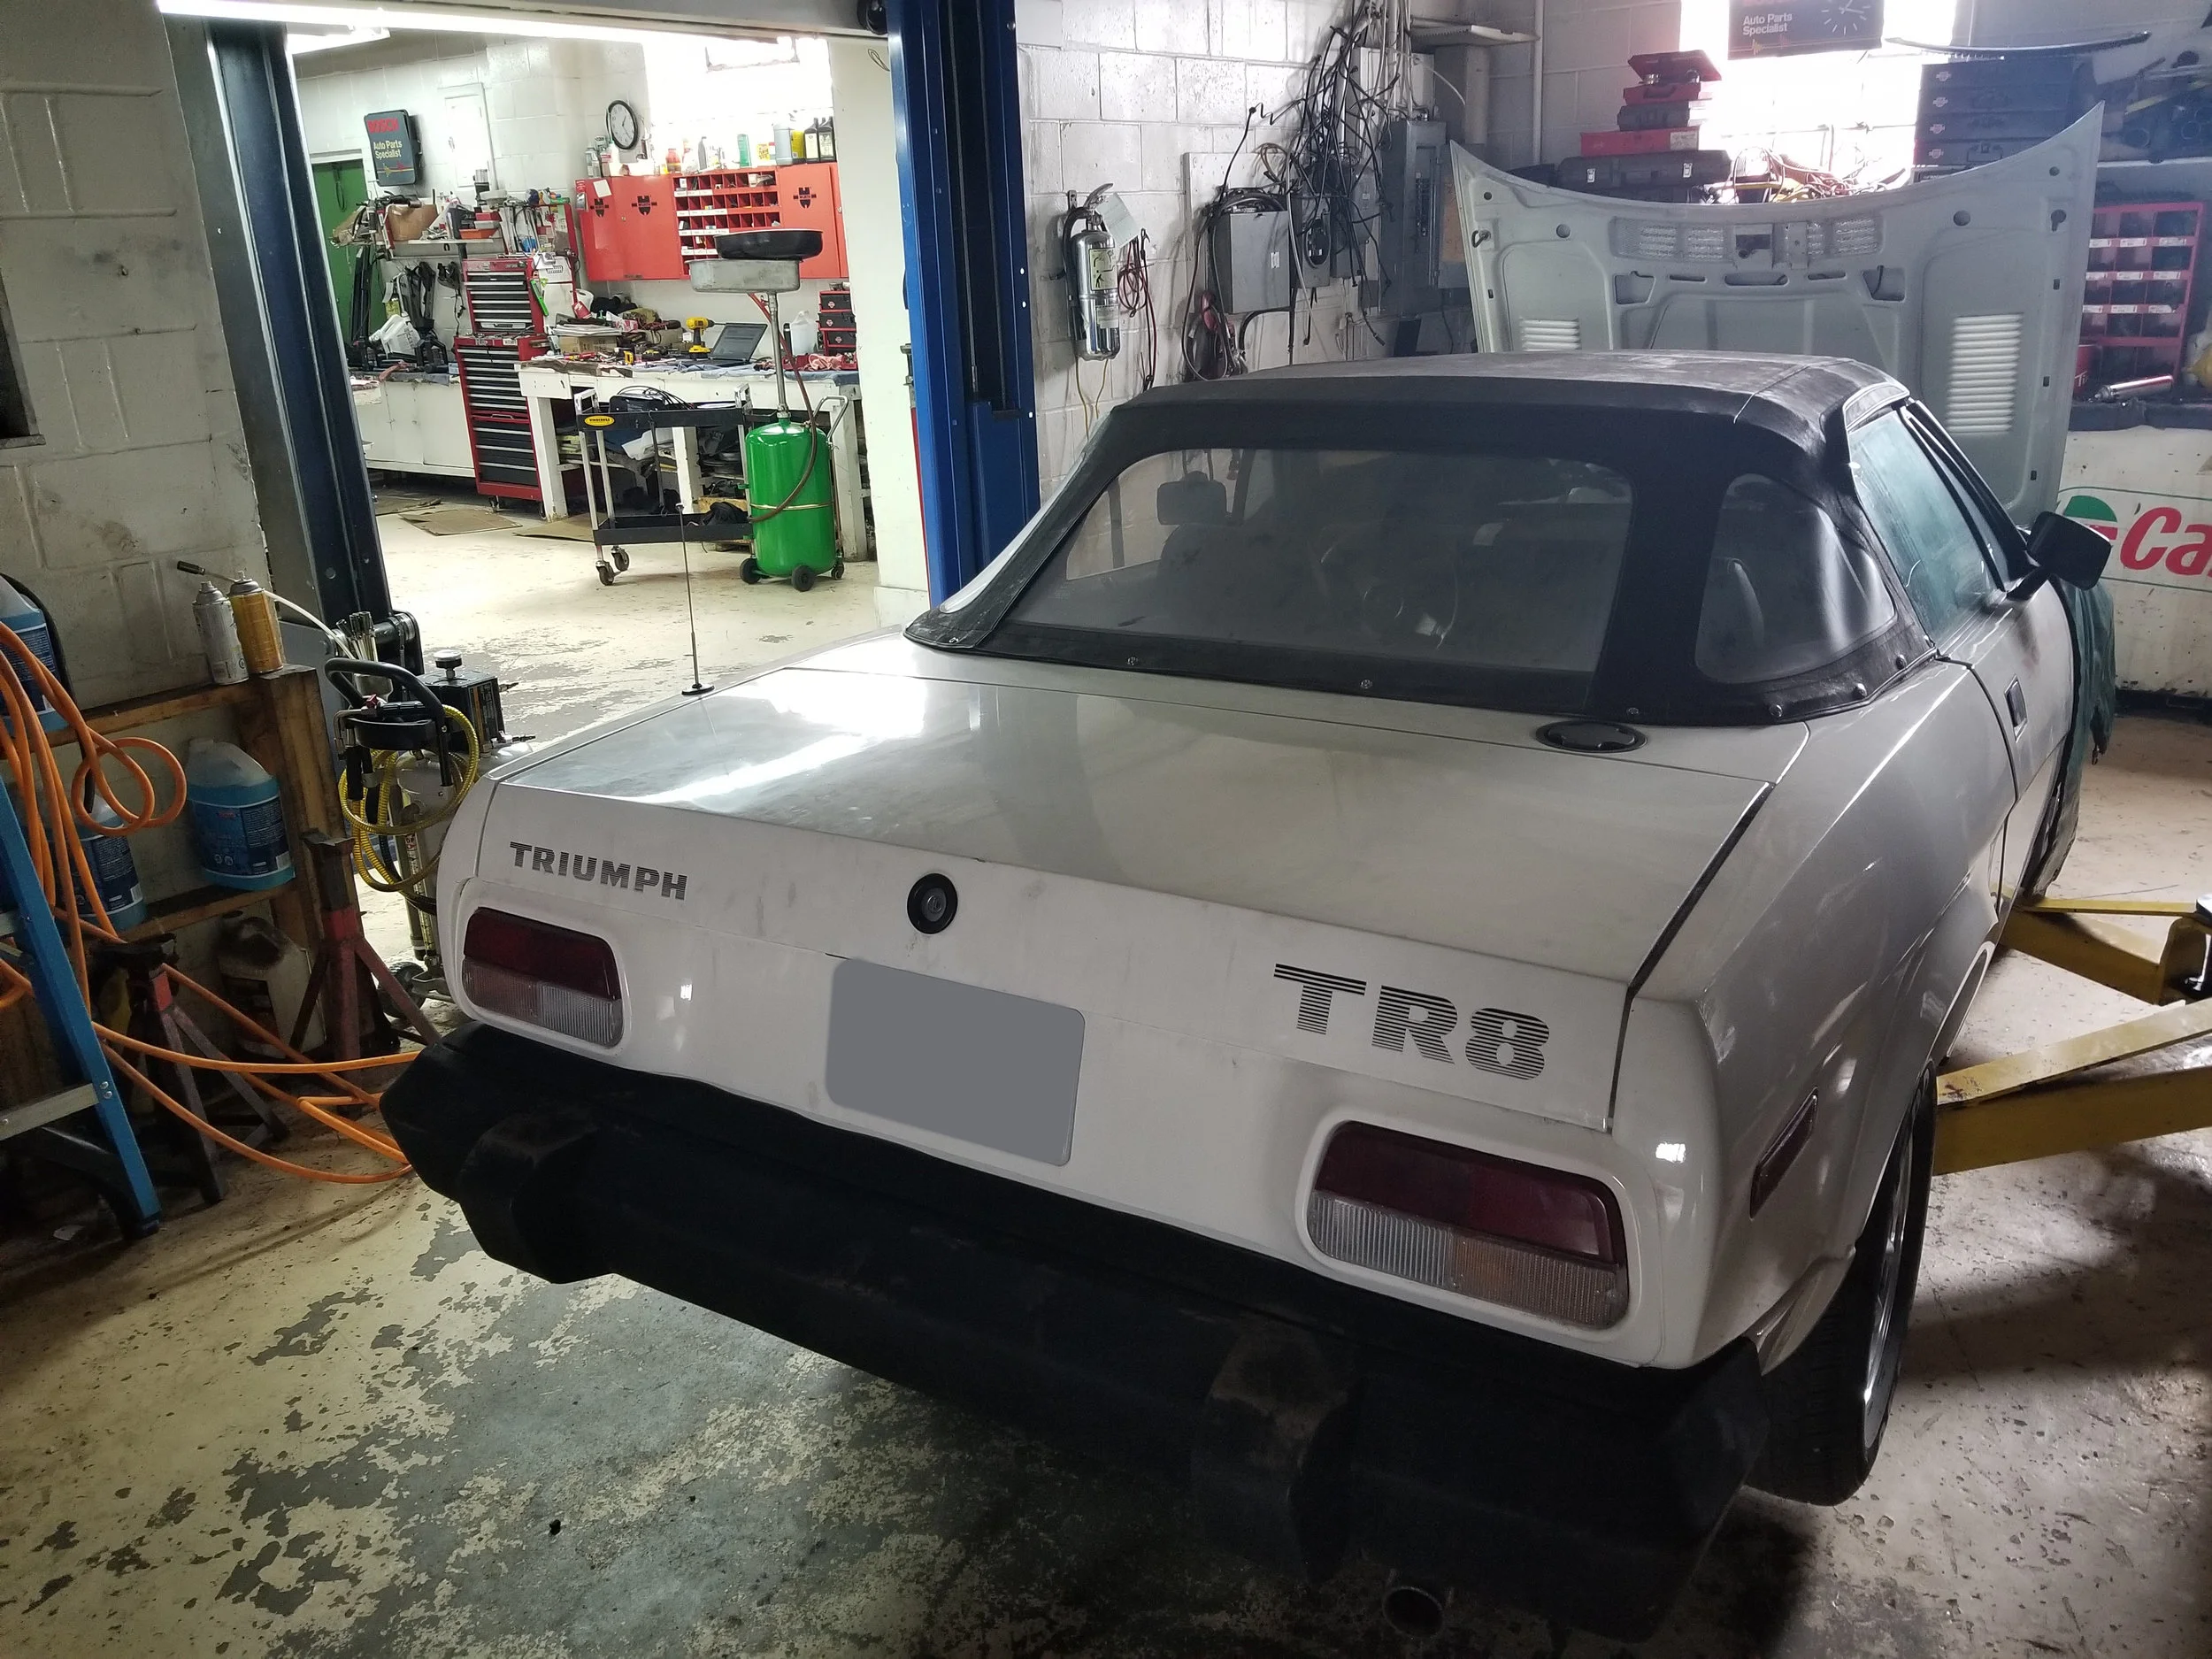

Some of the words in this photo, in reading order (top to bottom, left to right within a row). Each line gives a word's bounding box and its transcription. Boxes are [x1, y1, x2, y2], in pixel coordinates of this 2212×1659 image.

[1743, 15, 1765, 26] Auto
[1767, 12, 1793, 23] Parts
[1742, 22, 1787, 37] Specialist
[373, 141, 387, 150] Auto
[386, 139, 403, 150] Parts
[374, 149, 402, 161] Specialist
[2120, 506, 2212, 579] Ca
[510, 841, 687, 901] TRIUMPH
[1273, 963, 1550, 1080] TR8
